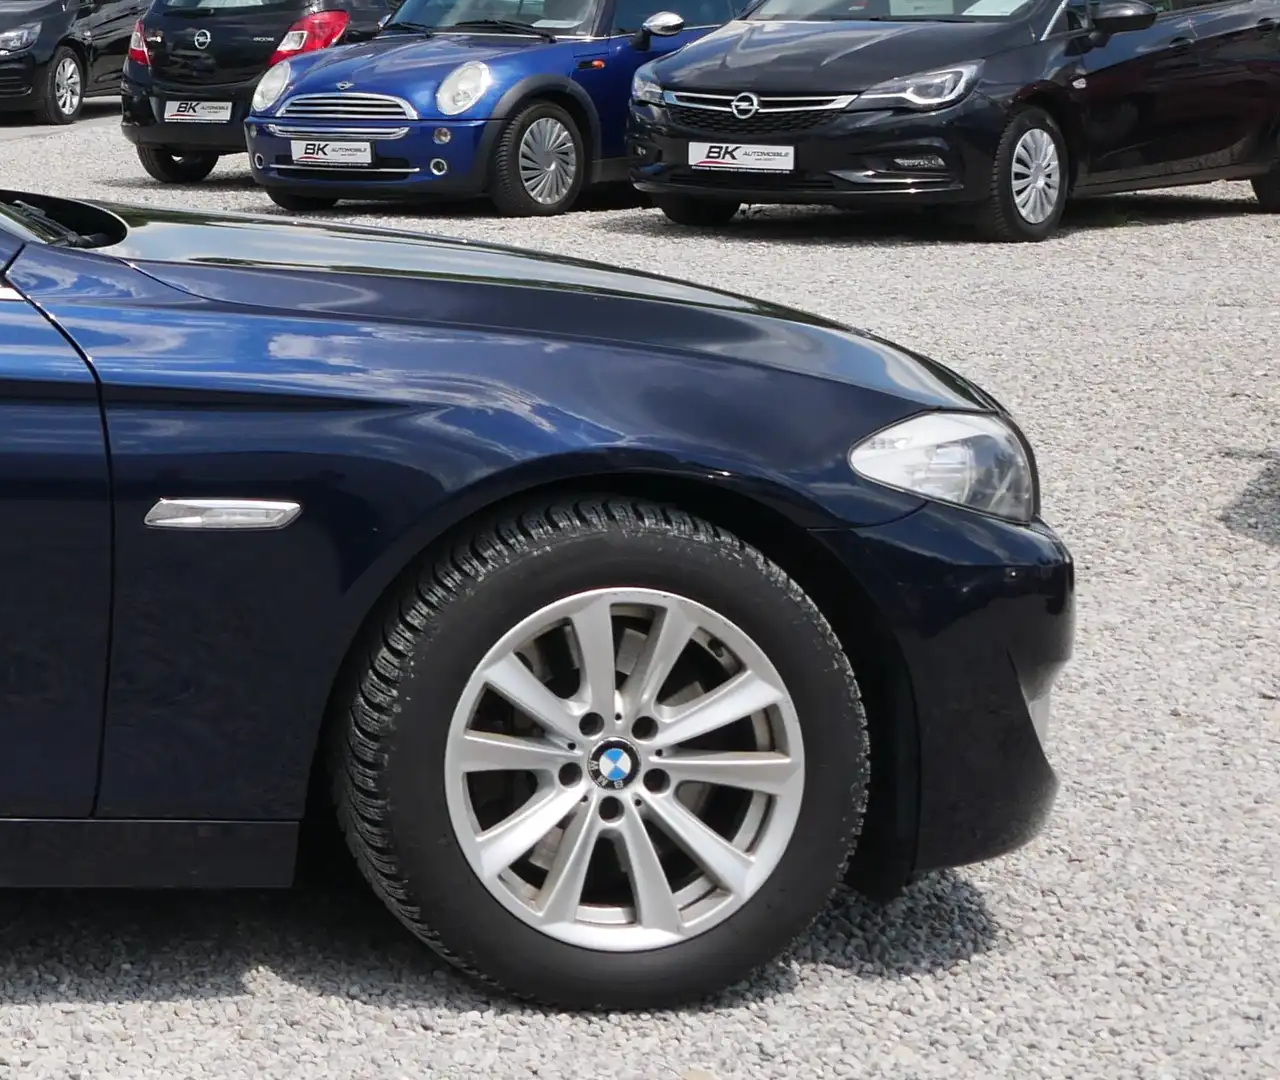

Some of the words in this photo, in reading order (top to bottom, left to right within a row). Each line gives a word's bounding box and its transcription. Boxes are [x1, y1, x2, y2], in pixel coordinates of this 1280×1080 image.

[176, 102, 201, 114] BK
[303, 143, 330, 156] BK
[705, 145, 742, 161] BK
[742, 150, 790, 158] AUTOMOBILE
